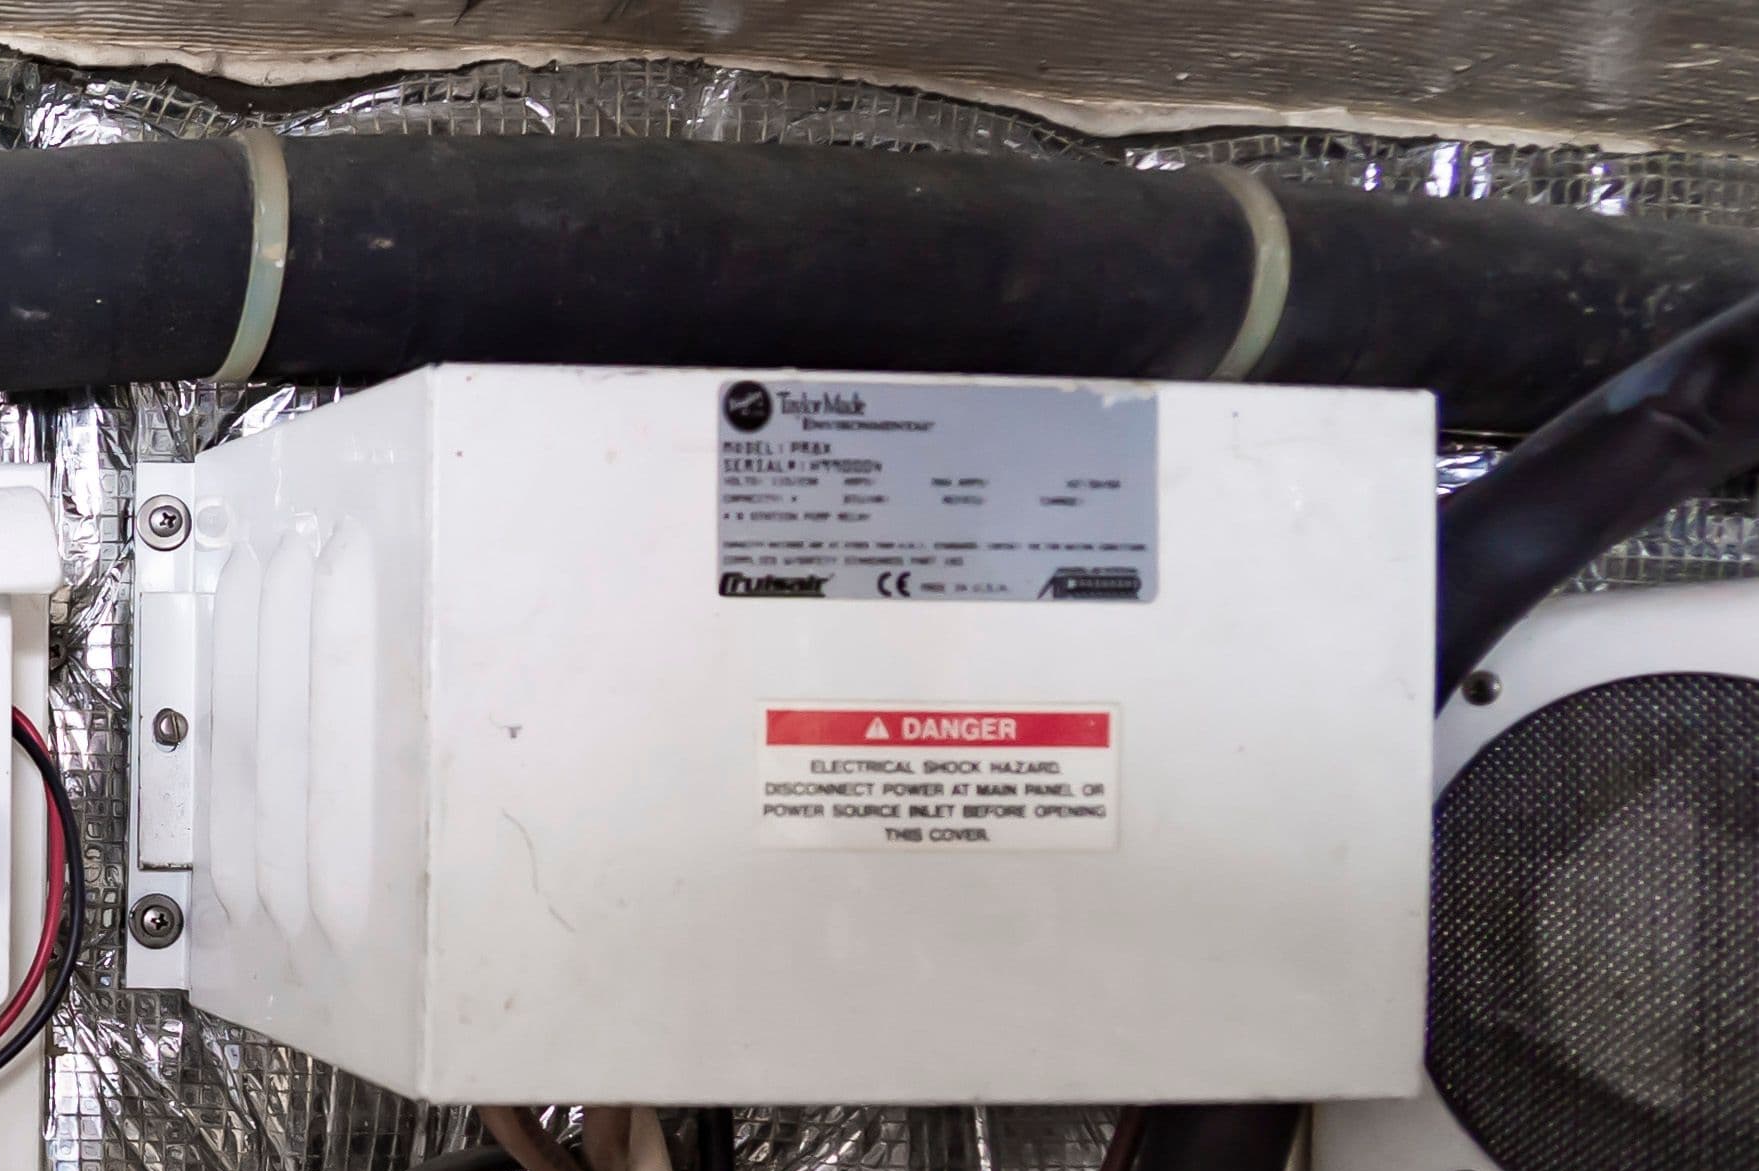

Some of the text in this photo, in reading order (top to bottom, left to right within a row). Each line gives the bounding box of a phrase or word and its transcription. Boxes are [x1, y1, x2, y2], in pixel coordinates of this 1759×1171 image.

[902, 716, 1017, 741] DANGER
[810, 760, 914, 775] ELECTRICAL
[923, 760, 981, 775] SHOCK
[764, 782, 1105, 798] DISCONNECT POWER AT MAIN PANEL OR
[763, 804, 1107, 819] POWER SOURCE INLET BEFORE OPENING
[885, 827, 923, 842] THIS
